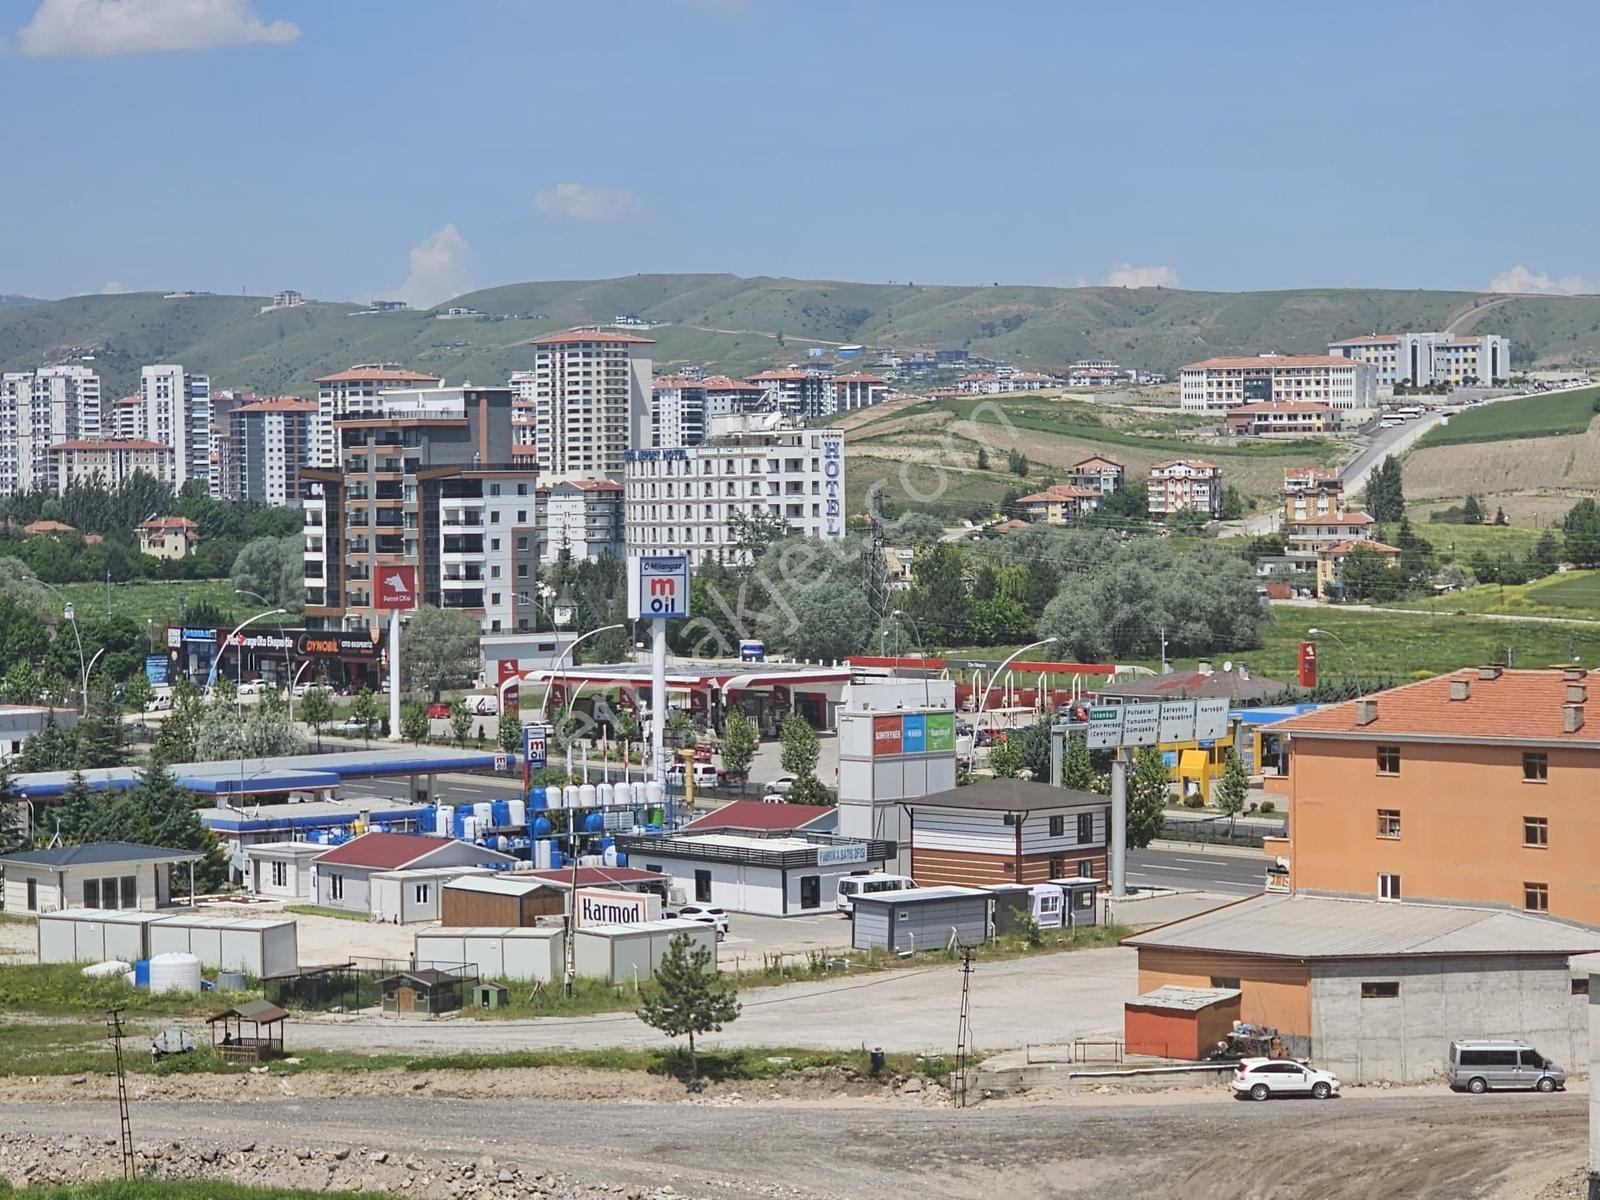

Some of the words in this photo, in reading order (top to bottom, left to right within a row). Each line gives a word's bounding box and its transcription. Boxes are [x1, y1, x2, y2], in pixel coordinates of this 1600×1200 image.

[824, 441, 840, 536] HOTEL
[651, 563, 682, 572] Milangaz
[651, 578, 675, 596] m
[651, 596, 675, 612] oil
[583, 898, 640, 924] Karmod
